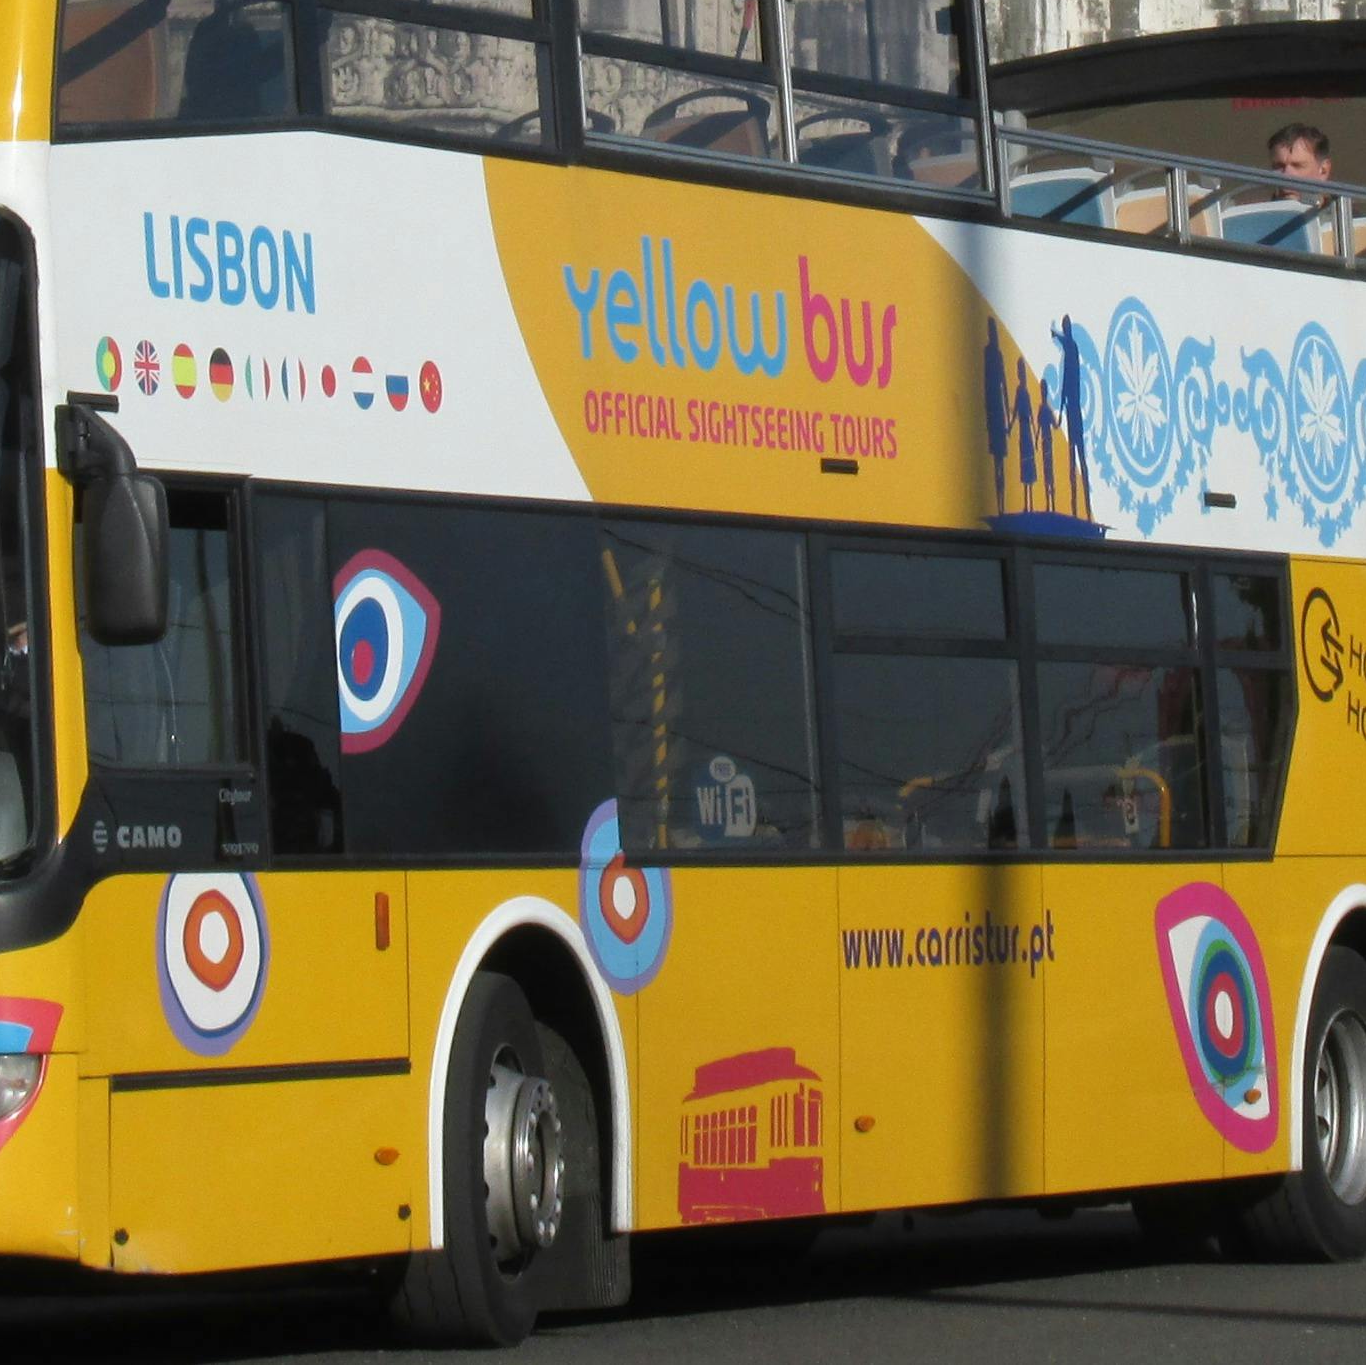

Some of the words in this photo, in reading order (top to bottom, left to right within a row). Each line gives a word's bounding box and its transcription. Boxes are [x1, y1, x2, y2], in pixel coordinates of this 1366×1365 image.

[144, 211, 316, 315] LISBON
[563, 235, 788, 379] yellow
[798, 255, 897, 390] bus
[584, 389, 682, 443] OFFICIAL
[687, 397, 826, 454] SIGHTSEEING
[830, 413, 898, 460] TOURS
[116, 825, 182, 850] CAMO
[842, 909, 1055, 978] www.carristur.pt
